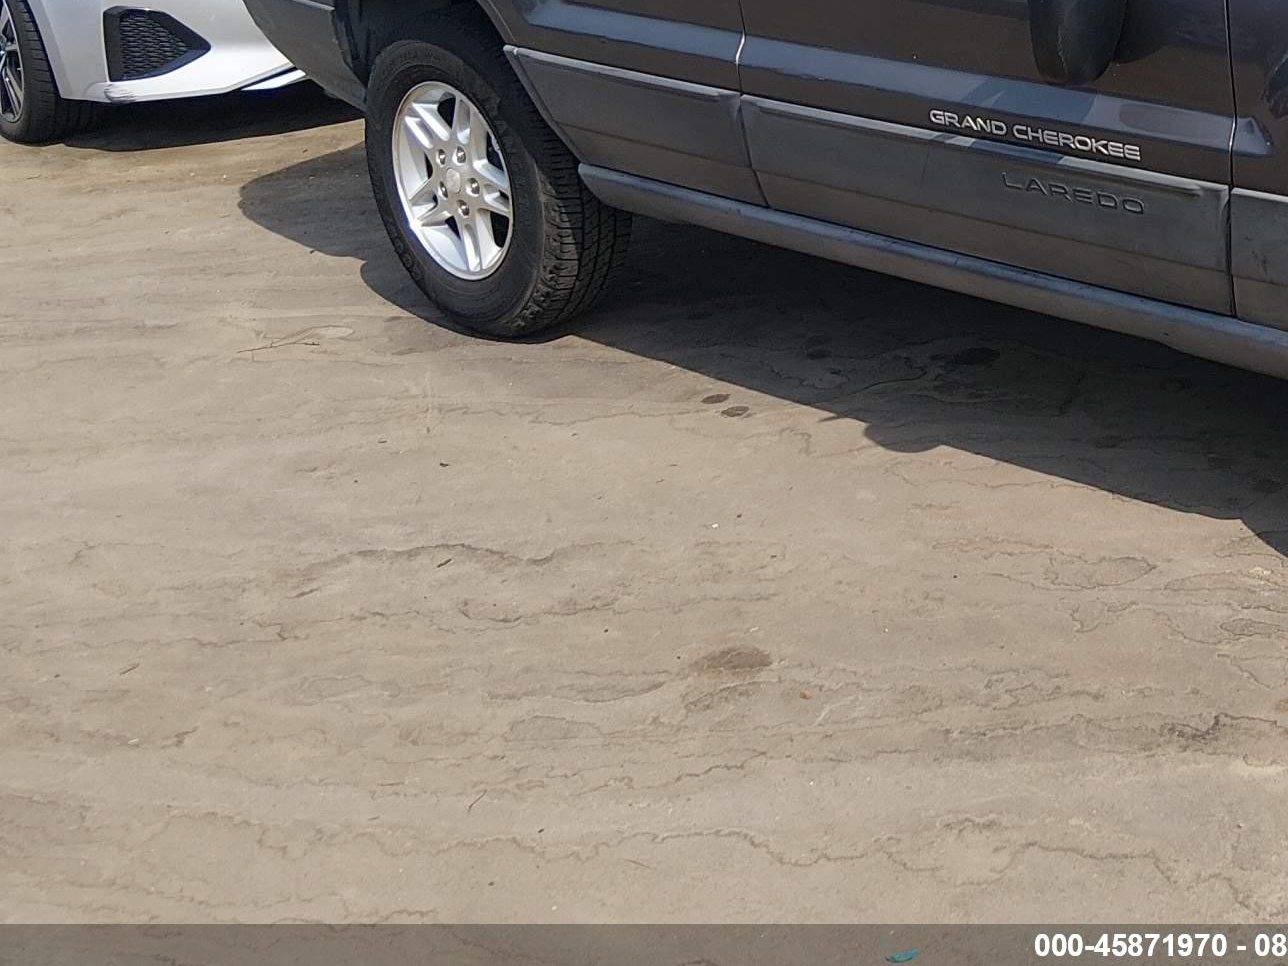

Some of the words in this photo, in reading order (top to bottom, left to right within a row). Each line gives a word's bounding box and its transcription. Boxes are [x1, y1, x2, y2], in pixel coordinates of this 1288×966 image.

[929, 108, 1008, 135] GRAND
[1012, 124, 1142, 161] CHEROKEE
[1001, 170, 1146, 215] LAREDO
